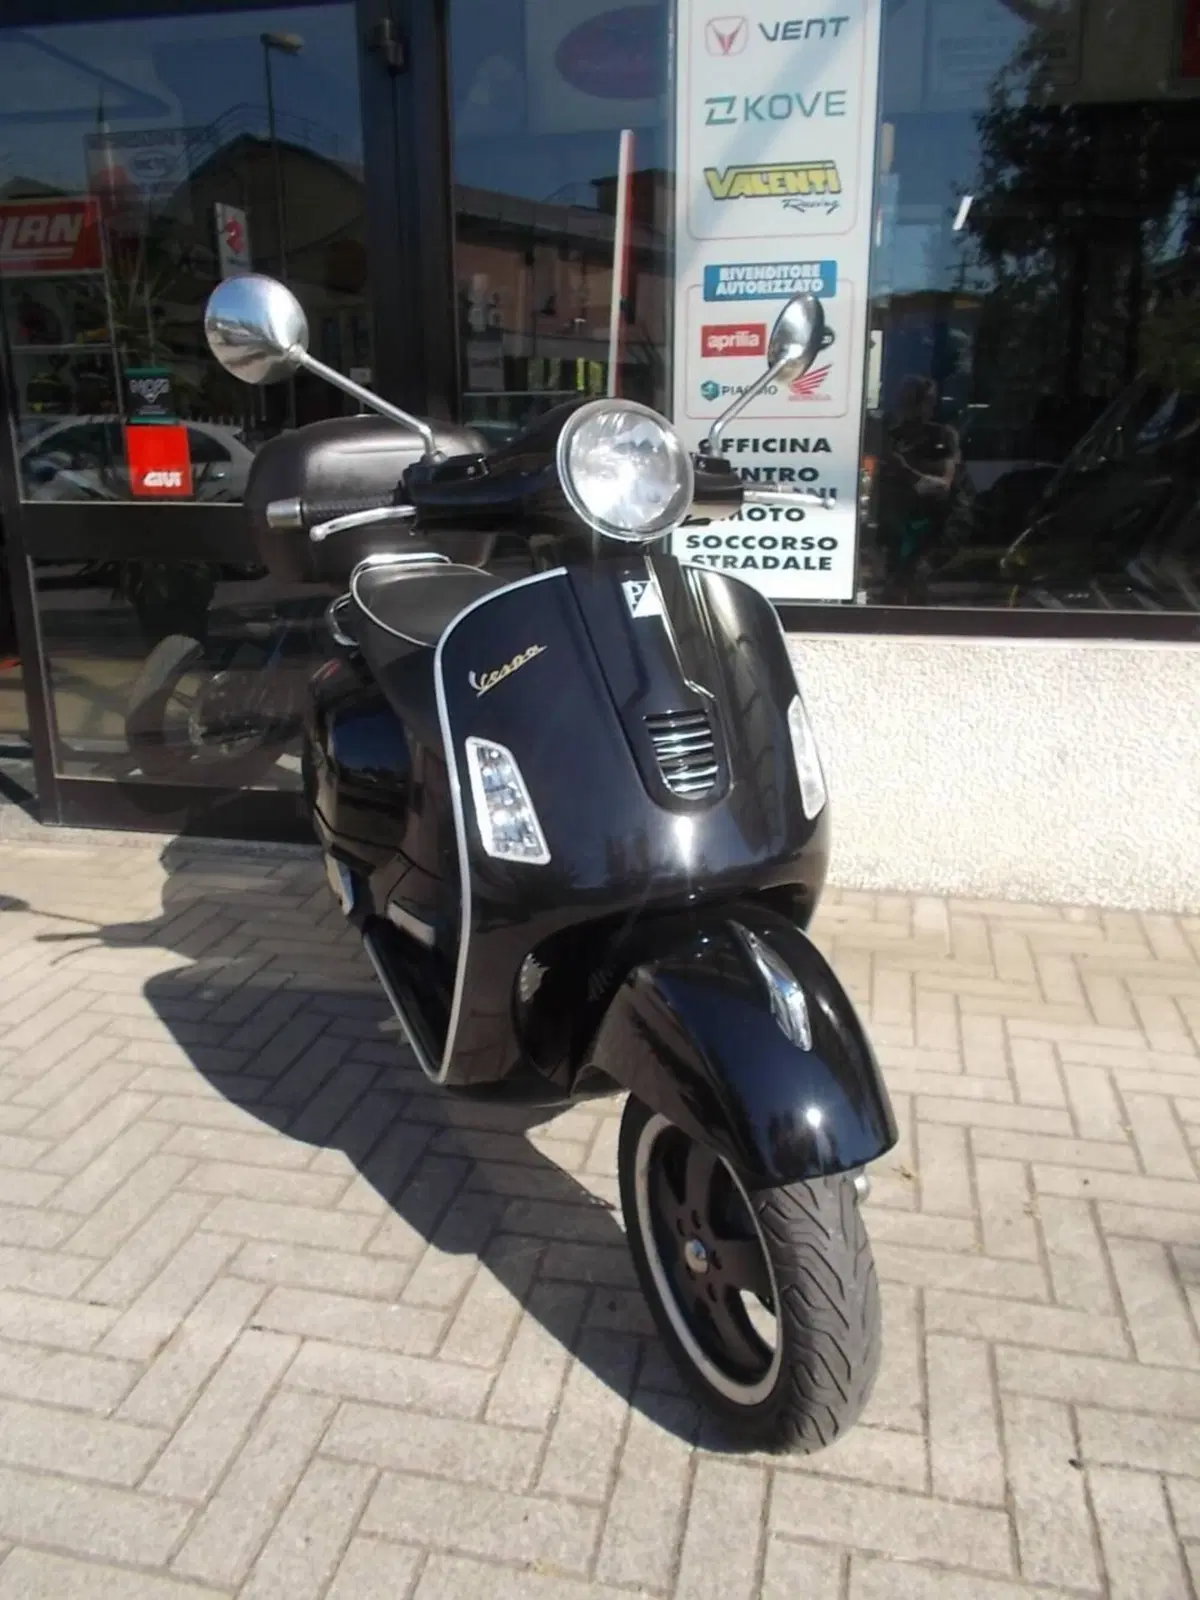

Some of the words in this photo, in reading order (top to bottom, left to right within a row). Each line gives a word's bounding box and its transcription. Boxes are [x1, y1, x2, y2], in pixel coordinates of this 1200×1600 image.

[758, 16, 850, 42] VENT
[743, 90, 848, 121] KOVE
[703, 160, 842, 200] VALENTI
[719, 263, 821, 281] RIVENDITORE
[715, 278, 824, 296] AUTORIZZATO
[707, 331, 761, 352] aprilia
[685, 534, 839, 551] SOCCORSO
[690, 554, 833, 571] STRADALE
[468, 644, 548, 697] Vespa
